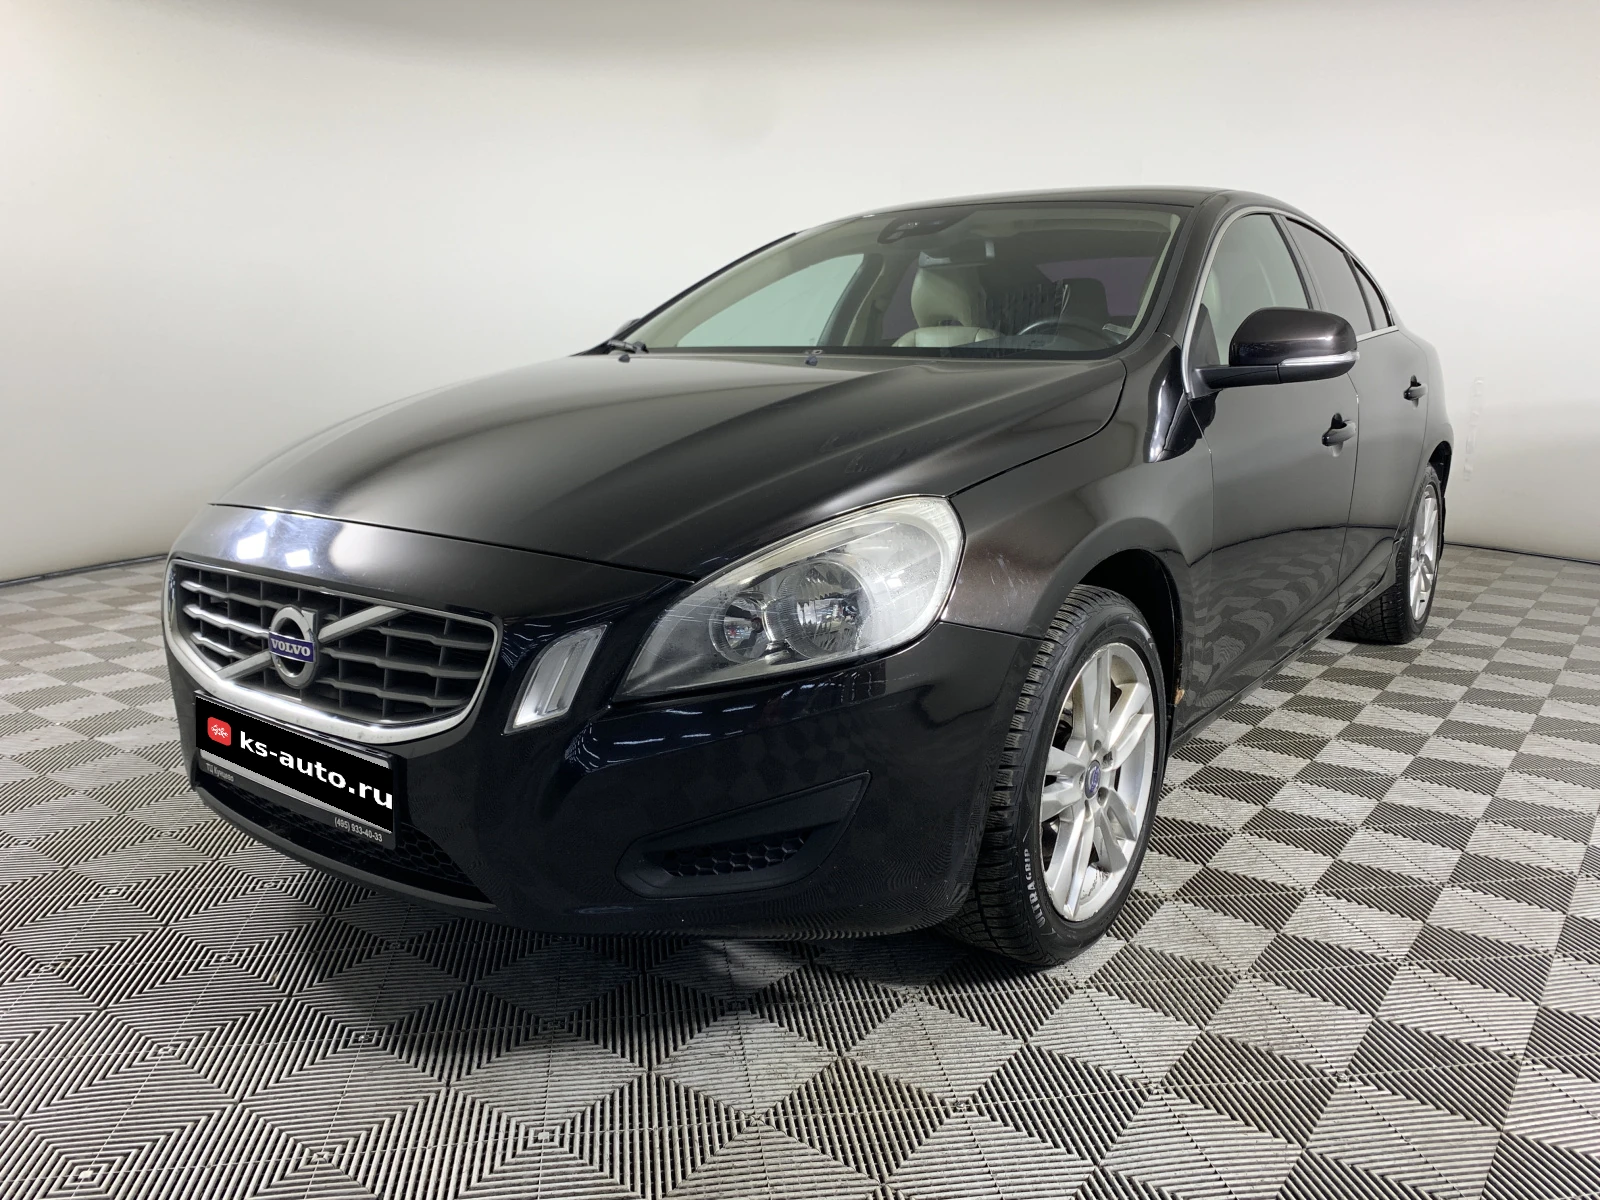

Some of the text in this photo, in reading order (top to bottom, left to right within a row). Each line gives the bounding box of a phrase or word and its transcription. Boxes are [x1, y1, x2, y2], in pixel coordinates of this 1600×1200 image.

[270, 637, 311, 657] VOLVO
[334, 816, 383, 843] (495) 933-40-33
[1023, 848, 1047, 929] ULTRAGRIP
